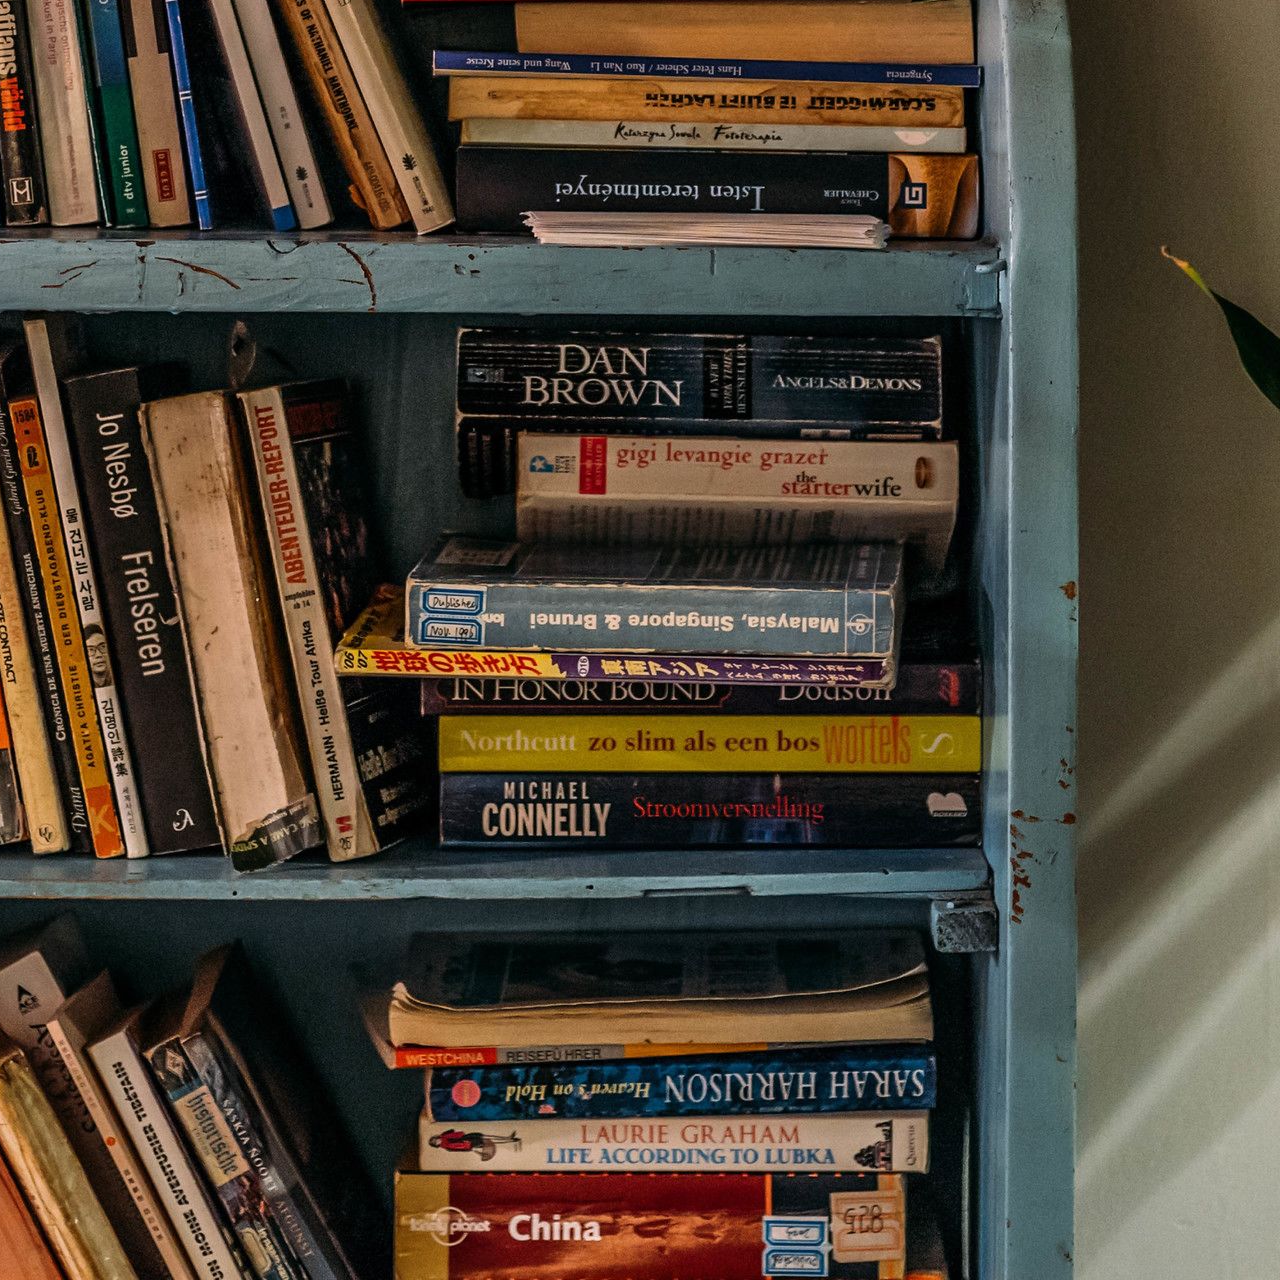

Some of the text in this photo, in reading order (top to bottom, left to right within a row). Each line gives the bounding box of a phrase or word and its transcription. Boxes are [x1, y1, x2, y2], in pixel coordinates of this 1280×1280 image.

[0, 76, 27, 131] värld
[555, 174, 767, 212] Isten teremtményei
[824, 189, 881, 202] CHEVALIER
[554, 344, 651, 375] DAN
[521, 376, 682, 408] BROWN
[615, 445, 828, 471] gigi levangie grazer
[95, 412, 167, 677] Jo Nesbø Frelseren
[527, 612, 838, 636] Malaysia, Singapore & Brunei
[370, 650, 542, 676] 地球の歩き方
[600, 659, 719, 678] 東南アジア
[459, 713, 909, 764] Northcutt zo slim als een bos wortels
[503, 779, 589, 800] MICHAEL
[481, 801, 610, 837] CONNELLY
[632, 792, 824, 822] Stroomversnelling
[504, 1066, 926, 1104] SARAH HARRISON Heaven's on Hold
[580, 1124, 801, 1145] LAURIE GRAHAM
[546, 1147, 837, 1165] LIFE ACCORDING TO LUBKA
[507, 1213, 602, 1242] China
